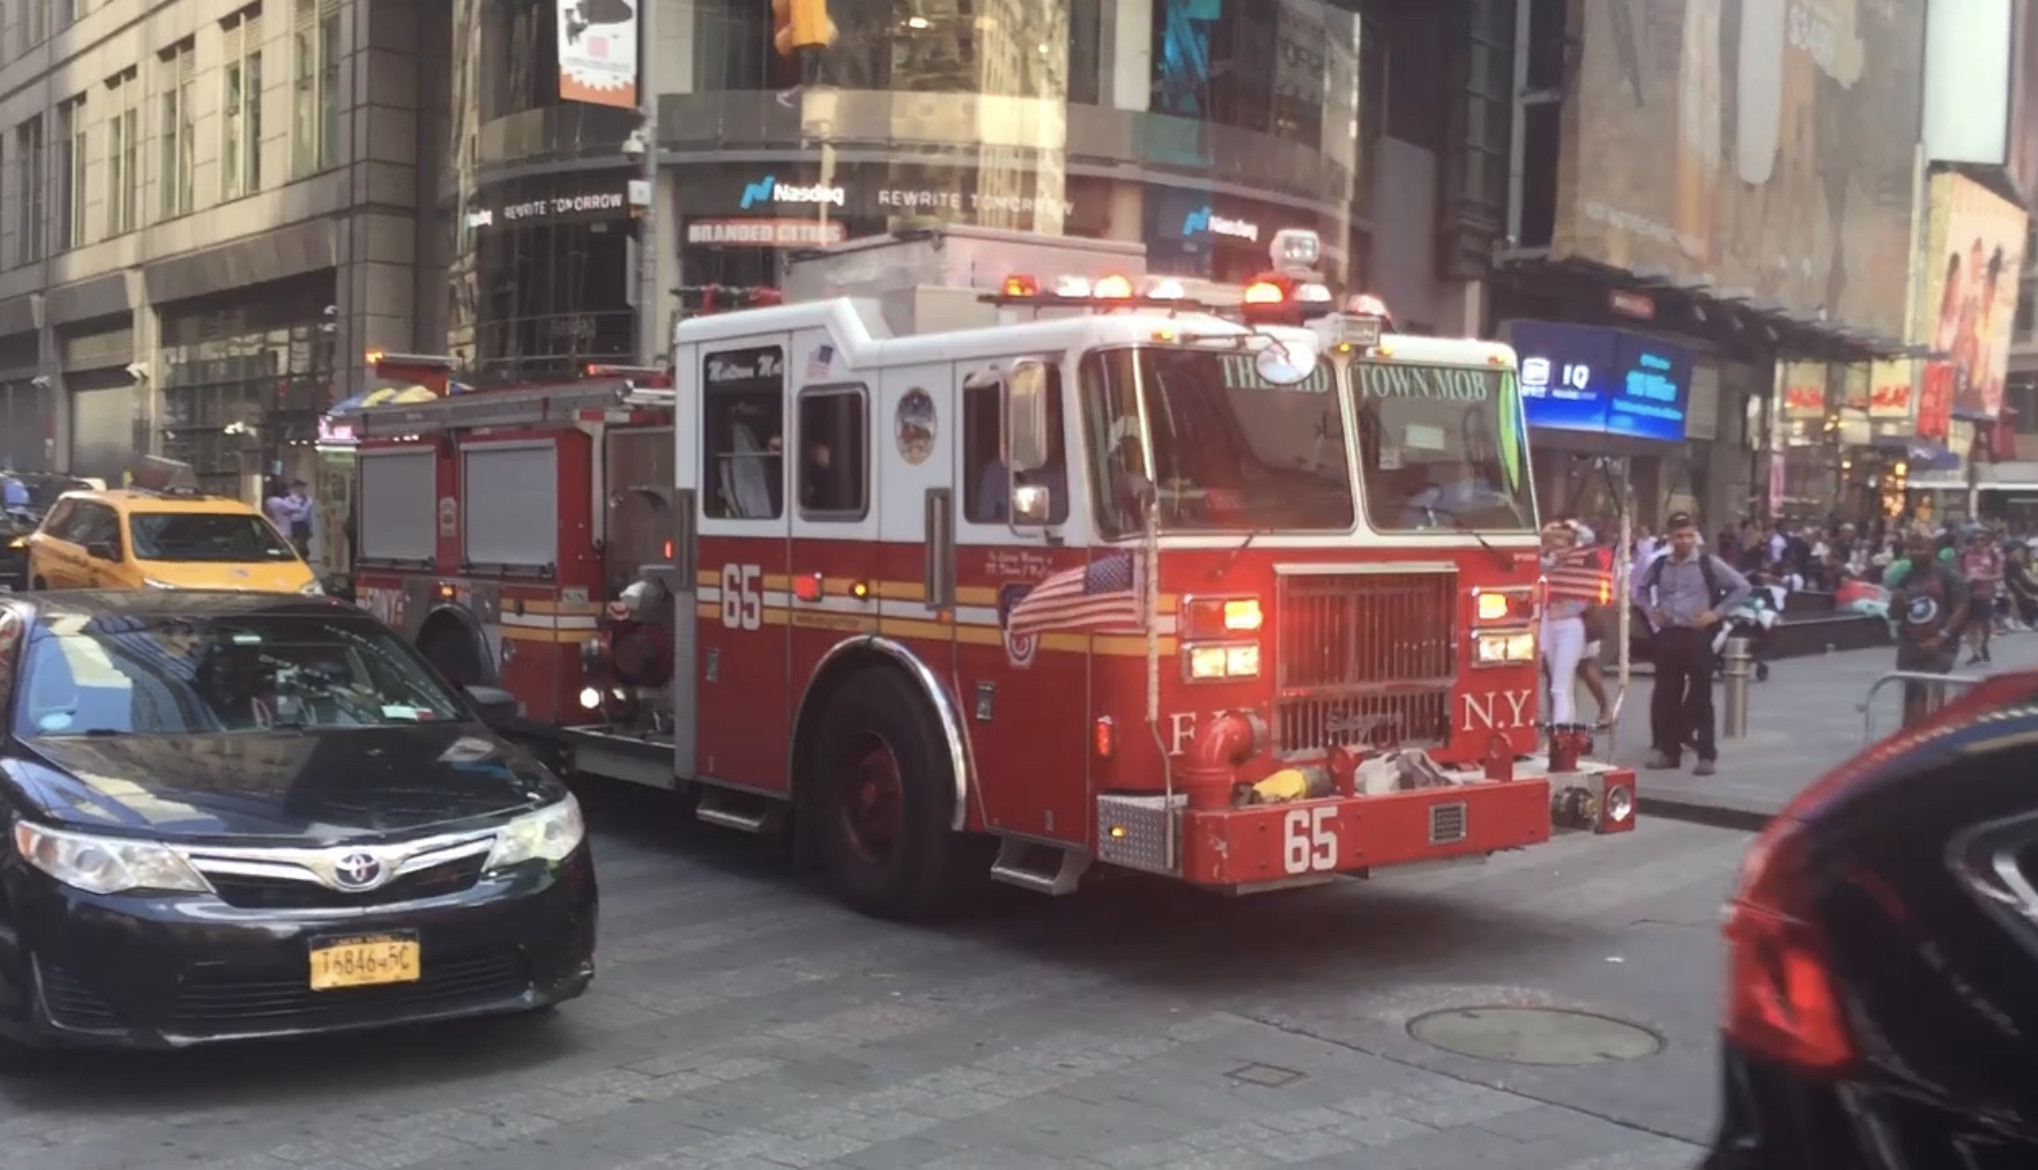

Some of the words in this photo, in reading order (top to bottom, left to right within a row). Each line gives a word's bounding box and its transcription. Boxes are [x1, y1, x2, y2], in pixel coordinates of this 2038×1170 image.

[774, 183, 844, 207] Nasdaq
[878, 189, 962, 209] REWRITE
[970, 194, 1075, 216] TOMORW
[688, 224, 773, 243] BRANDED
[1208, 216, 1258, 242] Nasdaq
[1216, 353, 1275, 389] TH
[1355, 364, 1429, 398] TOWN
[1433, 367, 1487, 401] MOB
[722, 563, 761, 631] 65
[1461, 689, 1535, 732] N.Y.
[1284, 806, 1338, 874] 65
